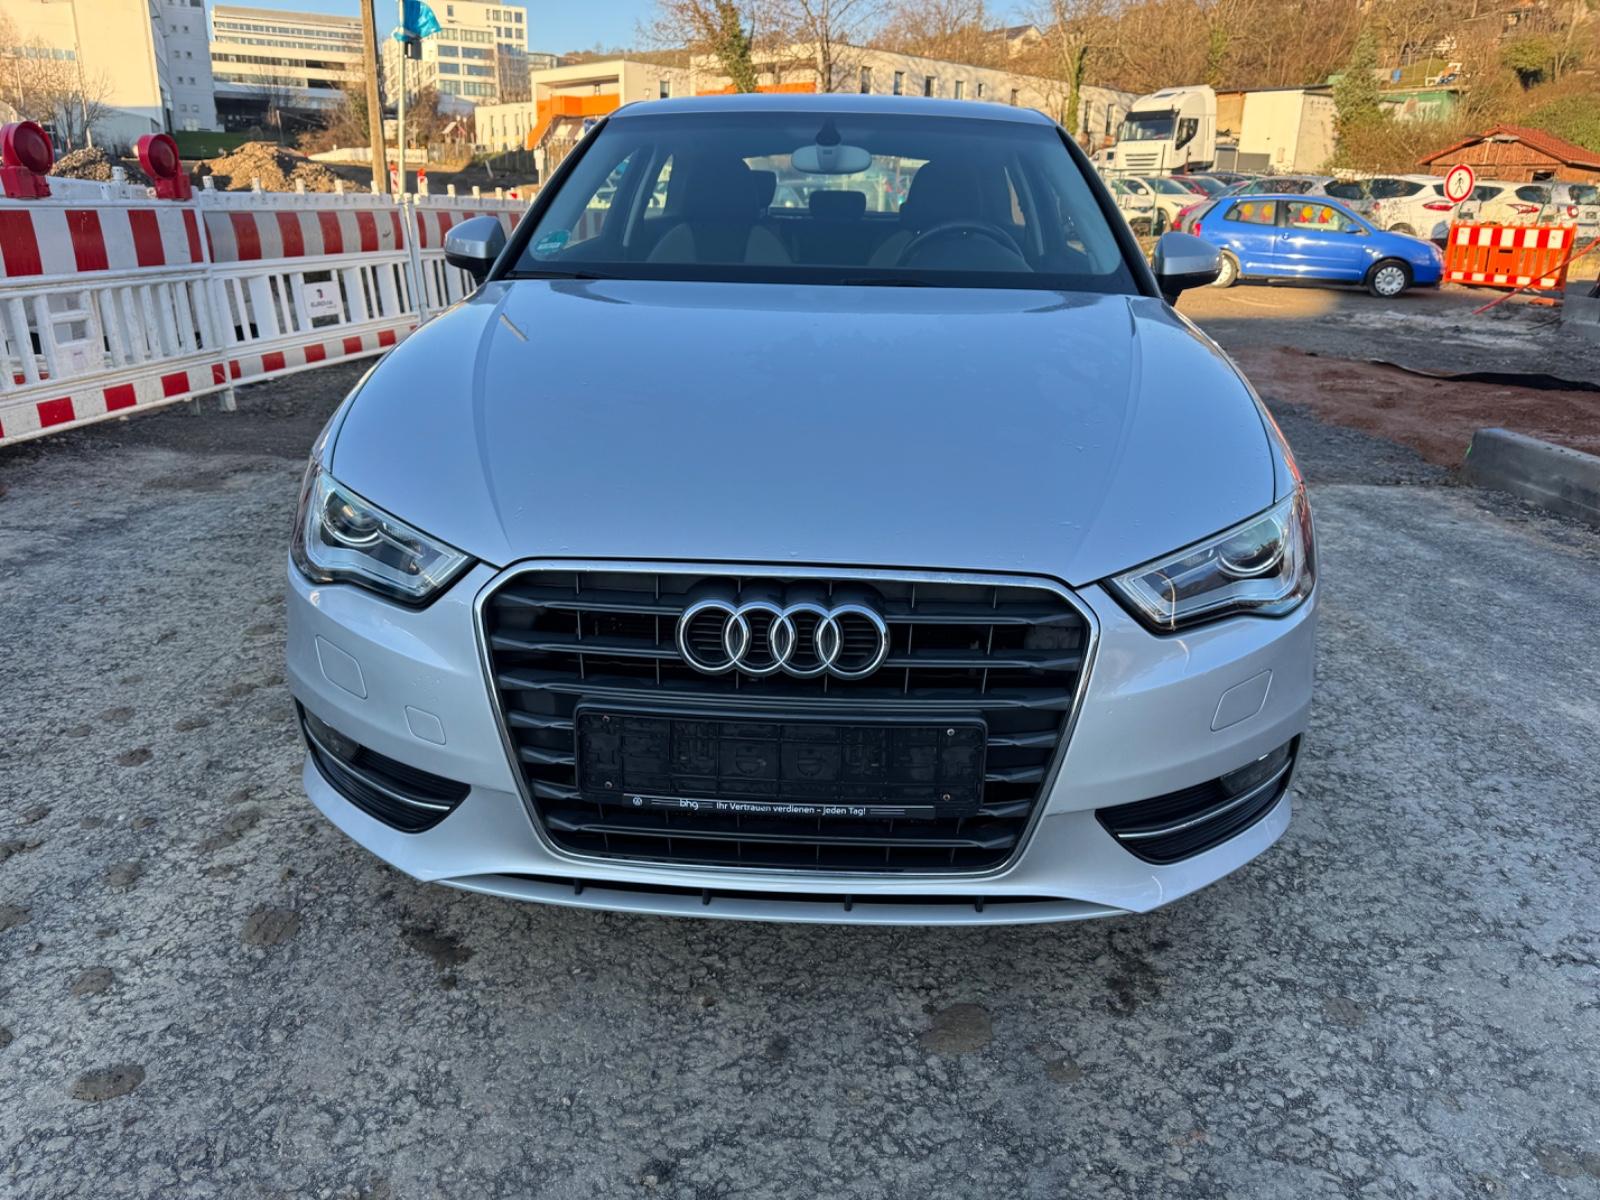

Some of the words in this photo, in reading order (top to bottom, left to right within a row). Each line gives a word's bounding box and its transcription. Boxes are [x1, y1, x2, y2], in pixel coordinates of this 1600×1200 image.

[679, 799, 699, 810] bhg
[716, 801, 727, 810] Ihr
[729, 802, 771, 813] Vertrauen
[773, 805, 815, 814] verdienen
[822, 806, 847, 816] jeden
[848, 807, 866, 817] Tag!
